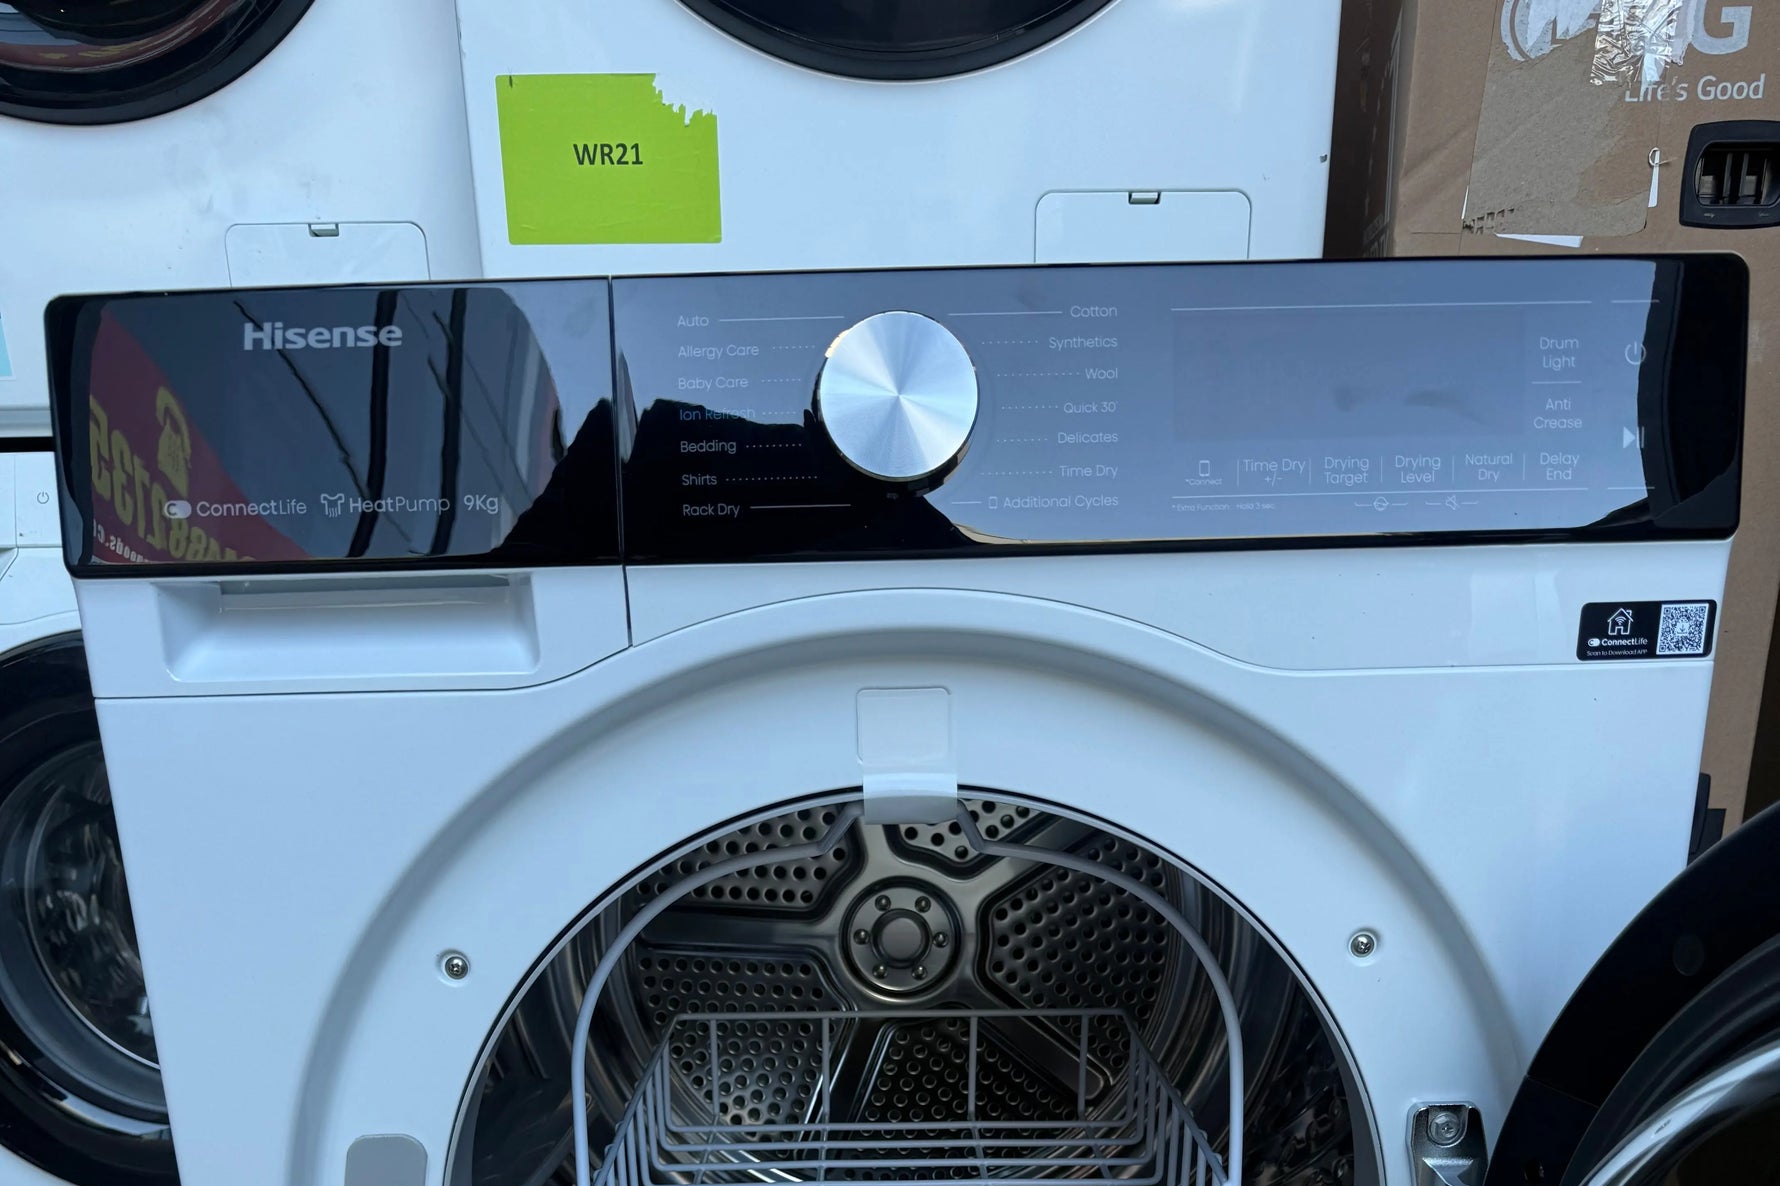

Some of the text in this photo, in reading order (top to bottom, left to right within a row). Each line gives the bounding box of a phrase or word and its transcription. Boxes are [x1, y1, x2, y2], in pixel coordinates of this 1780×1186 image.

[1697, 73, 1766, 101] Good
[572, 143, 644, 165] WR21
[1070, 305, 1118, 318] Cotton
[677, 315, 709, 327] Auto
[243, 321, 403, 351] Hisense
[1539, 336, 1580, 350] Drum
[1049, 336, 1118, 351] Synthetics
[678, 344, 760, 360] Allergy Care
[1542, 355, 1576, 371] Light
[1085, 368, 1118, 380] Wool
[678, 376, 749, 392] Baby Care
[1064, 401, 1098, 415] Quick
[1545, 398, 1572, 411] Anti
[680, 407, 756, 421] Ion Refresh
[1533, 417, 1582, 429] Crease
[1057, 431, 1119, 444] Delicates
[680, 440, 737, 455] Bedding
[1243, 458, 1306, 474] Time Dry
[1324, 456, 1370, 472] Drying
[1395, 455, 1441, 470] Drying
[1465, 453, 1513, 465] Natural
[1540, 452, 1580, 468] Delay
[1059, 465, 1119, 479] Time Dry
[1324, 471, 1368, 486] Target
[1400, 470, 1435, 483] Level
[1478, 468, 1501, 482] Dry
[1546, 468, 1572, 481] End
[681, 473, 718, 486] Shirts
[196, 499, 307, 517] ConnectLife
[350, 495, 450, 515] HeatPump
[463, 494, 499, 514] 9Kg
[1003, 495, 1119, 509] Additional Cycles
[682, 503, 741, 518] Rack Dry
[1601, 637, 1648, 646] ConnectLife
